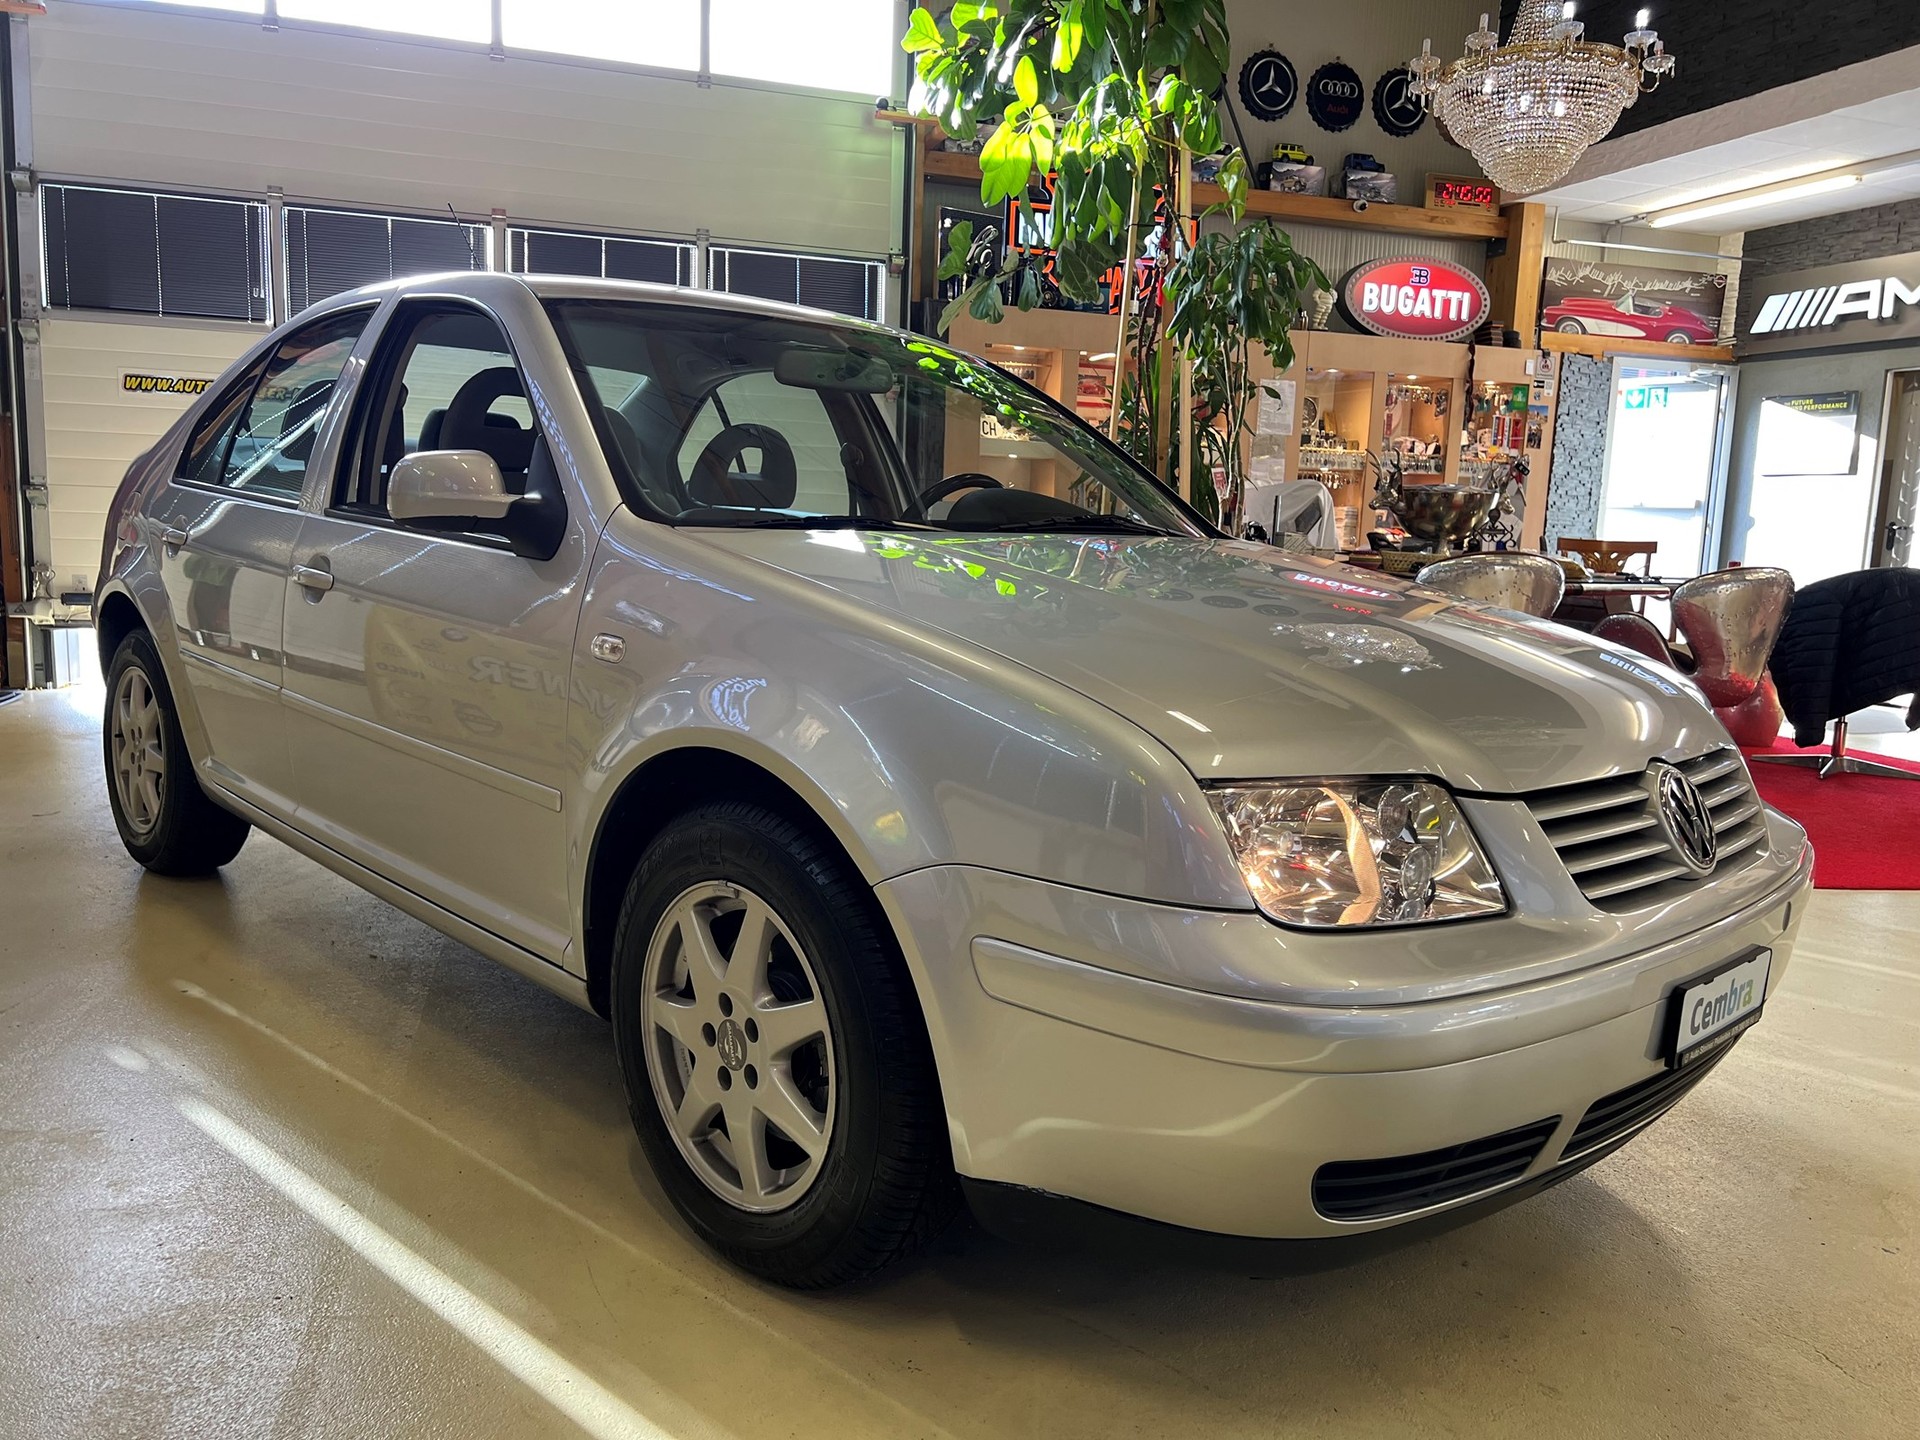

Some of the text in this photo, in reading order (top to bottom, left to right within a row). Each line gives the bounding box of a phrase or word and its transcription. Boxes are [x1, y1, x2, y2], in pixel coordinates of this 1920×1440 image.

[1327, 103, 1349, 114] Audi
[1362, 282, 1471, 322] BUGATTI
[1803, 402, 1848, 411] PERFORMANCE
[982, 420, 997, 436] CH
[1690, 978, 1754, 1036] Cembra
